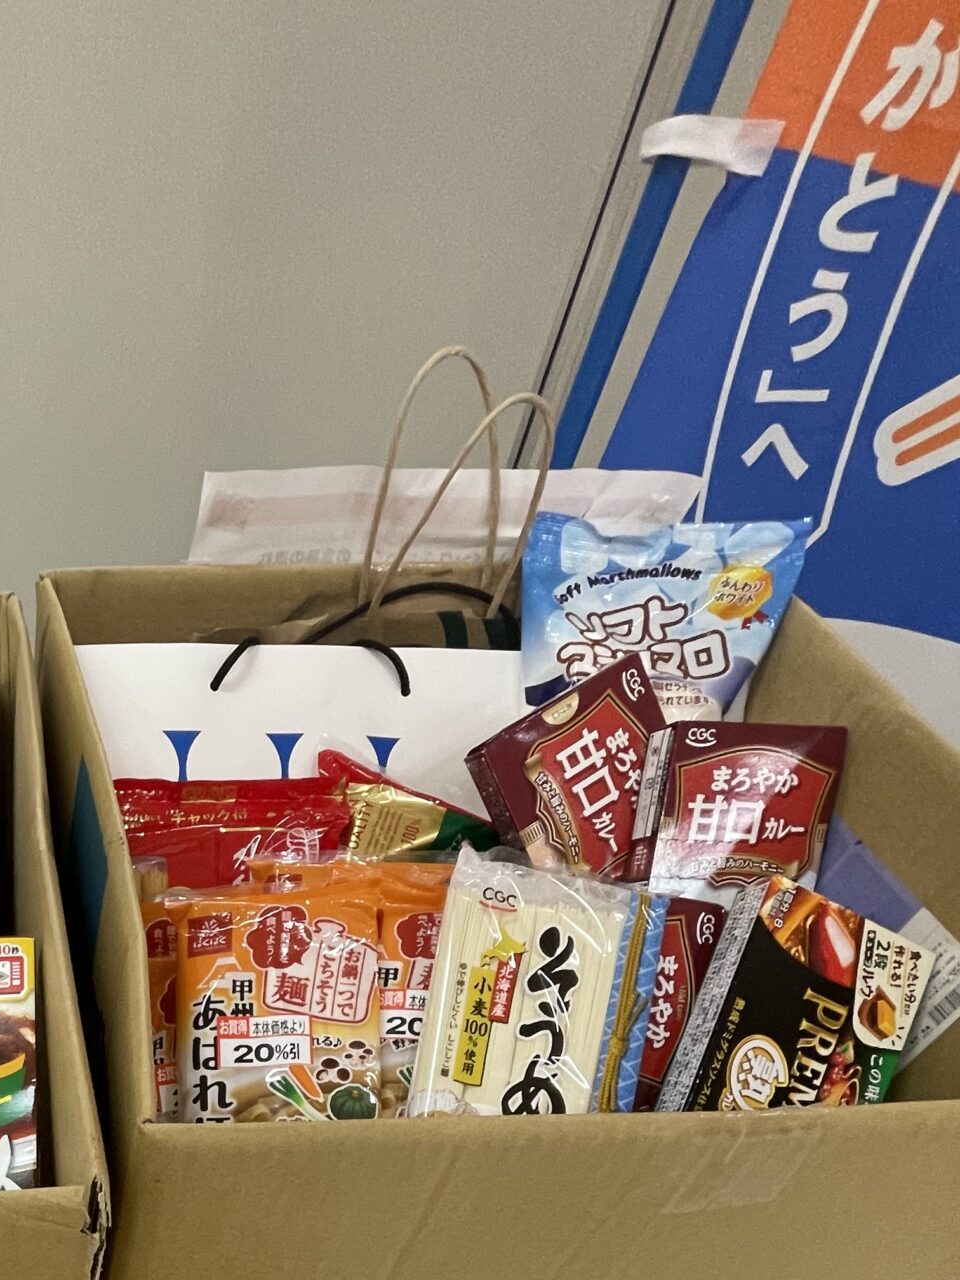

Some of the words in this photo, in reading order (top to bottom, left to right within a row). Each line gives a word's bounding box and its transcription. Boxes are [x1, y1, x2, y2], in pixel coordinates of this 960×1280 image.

[587, 563, 702, 588] Marshmallows
[565, 595, 688, 644] ソフト
[626, 668, 645, 698] CGC
[688, 728, 717, 742] CGC
[711, 765, 799, 794] まろやか
[482, 886, 518, 908] CGC
[701, 914, 716, 944] CGC
[271, 972, 311, 1008] 麺
[337, 949, 362, 1018] お鍋一つで
[490, 964, 513, 1018] 北海道産
[645, 955, 679, 1049] まろやか
[218, 1019, 248, 1036] お買得
[252, 1019, 306, 1035] 本体価格より
[461, 976, 494, 1077] 小麦100%使用
[233, 1042, 301, 1065] 20%引
